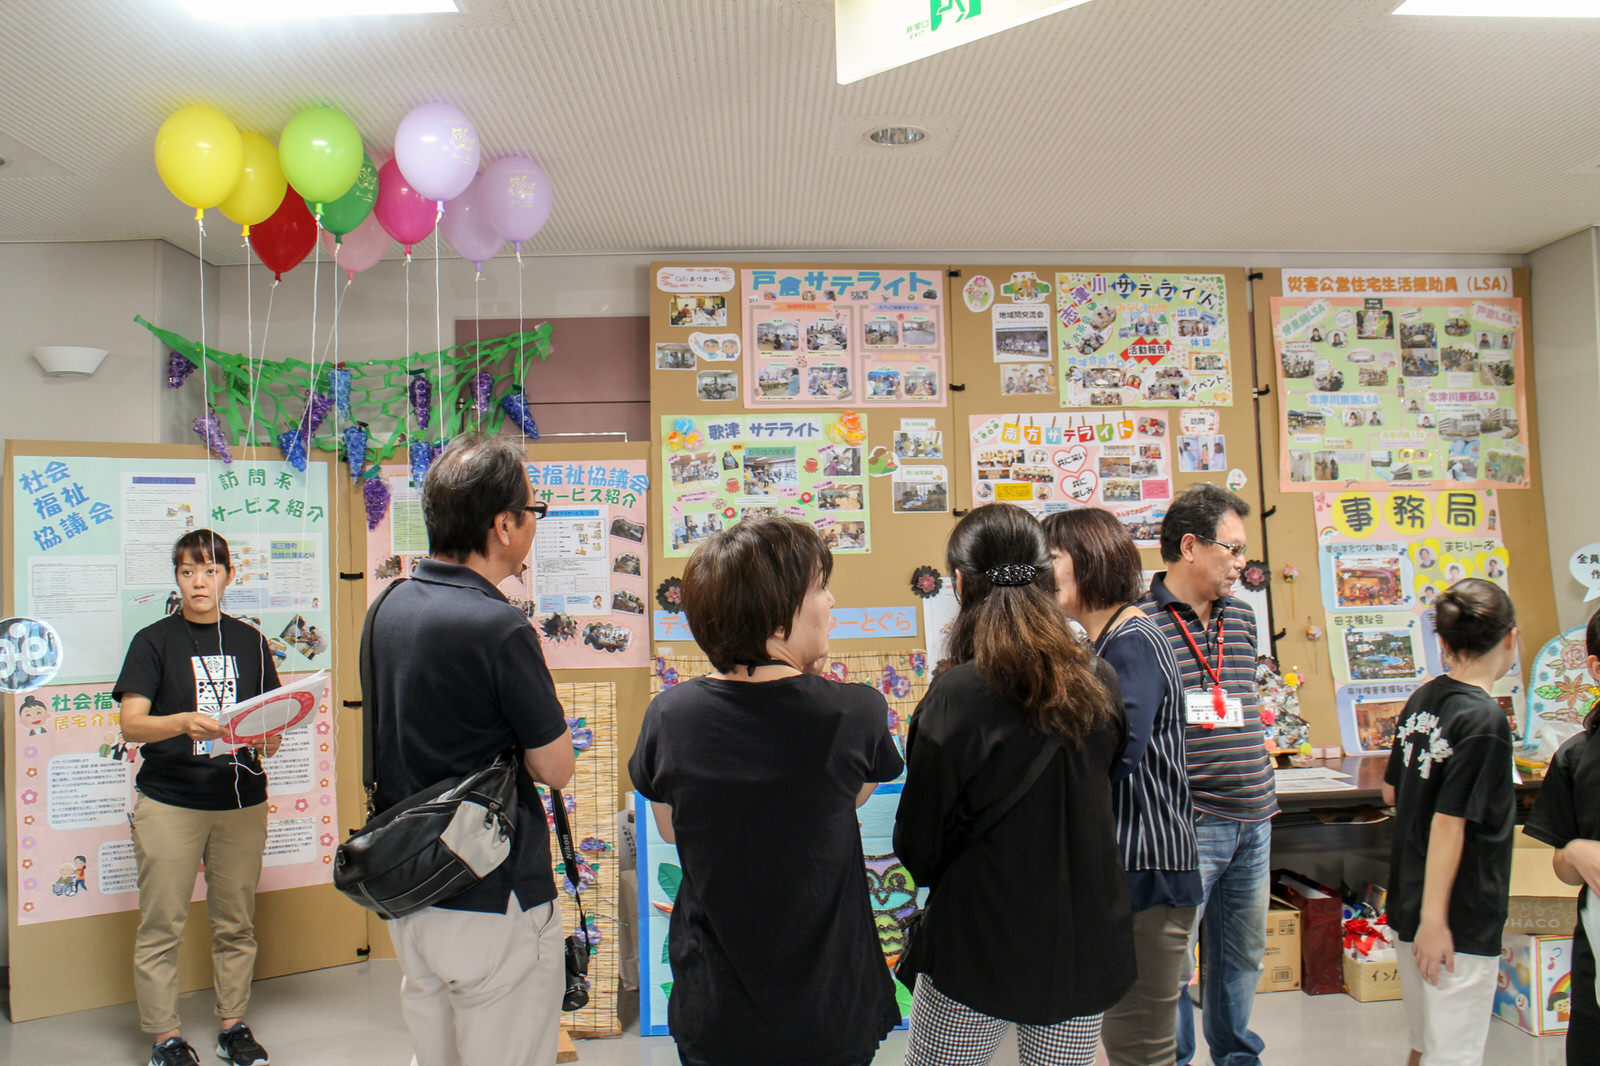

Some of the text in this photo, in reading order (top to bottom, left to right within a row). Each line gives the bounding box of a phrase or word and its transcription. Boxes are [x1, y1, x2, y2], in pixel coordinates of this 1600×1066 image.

[751, 270, 933, 297] 戸倉サテライト
[1060, 276, 1217, 326] 志津川サテライト
[999, 311, 1044, 319] 地域間交流会
[1128, 345, 1167, 355] 活動報告
[1190, 375, 1224, 392] イベント
[709, 422, 820, 440] 歌津 サテライト
[1004, 421, 1135, 444] 南方サテライト
[19, 461, 71, 495] 社会
[219, 469, 293, 491] 訪問系
[33, 483, 90, 519] 福祉
[212, 498, 324, 523] サービス紹介
[1341, 492, 1477, 532] 事務局
[33, 502, 114, 551] 協議会
